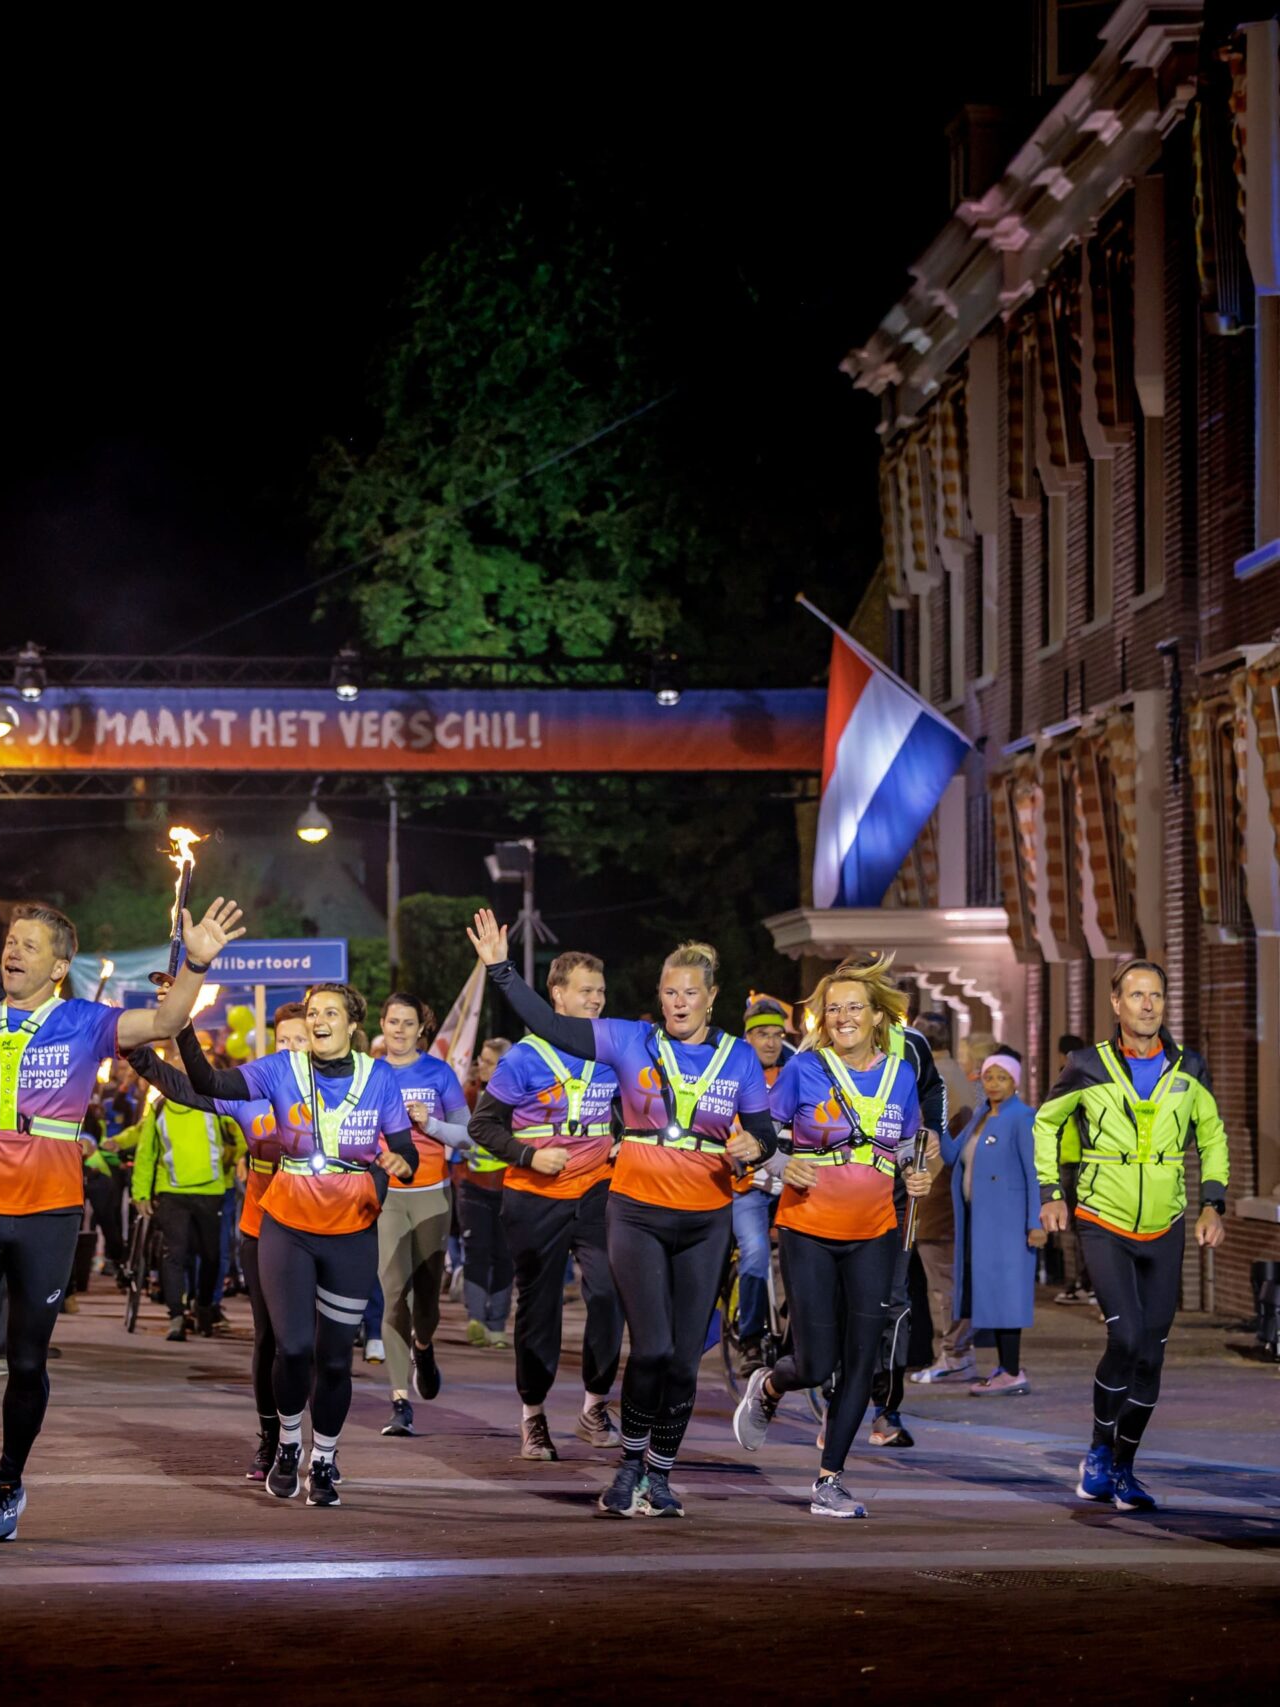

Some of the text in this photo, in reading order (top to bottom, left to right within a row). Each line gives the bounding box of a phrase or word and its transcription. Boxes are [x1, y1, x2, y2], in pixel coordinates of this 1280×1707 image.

[95, 706, 237, 748] MAAKT
[250, 708, 326, 748] HET
[338, 709, 541, 750] VERSCHIL!
[211, 955, 312, 970] Wilbertoord
[22, 1053, 70, 1066] AFETTE
